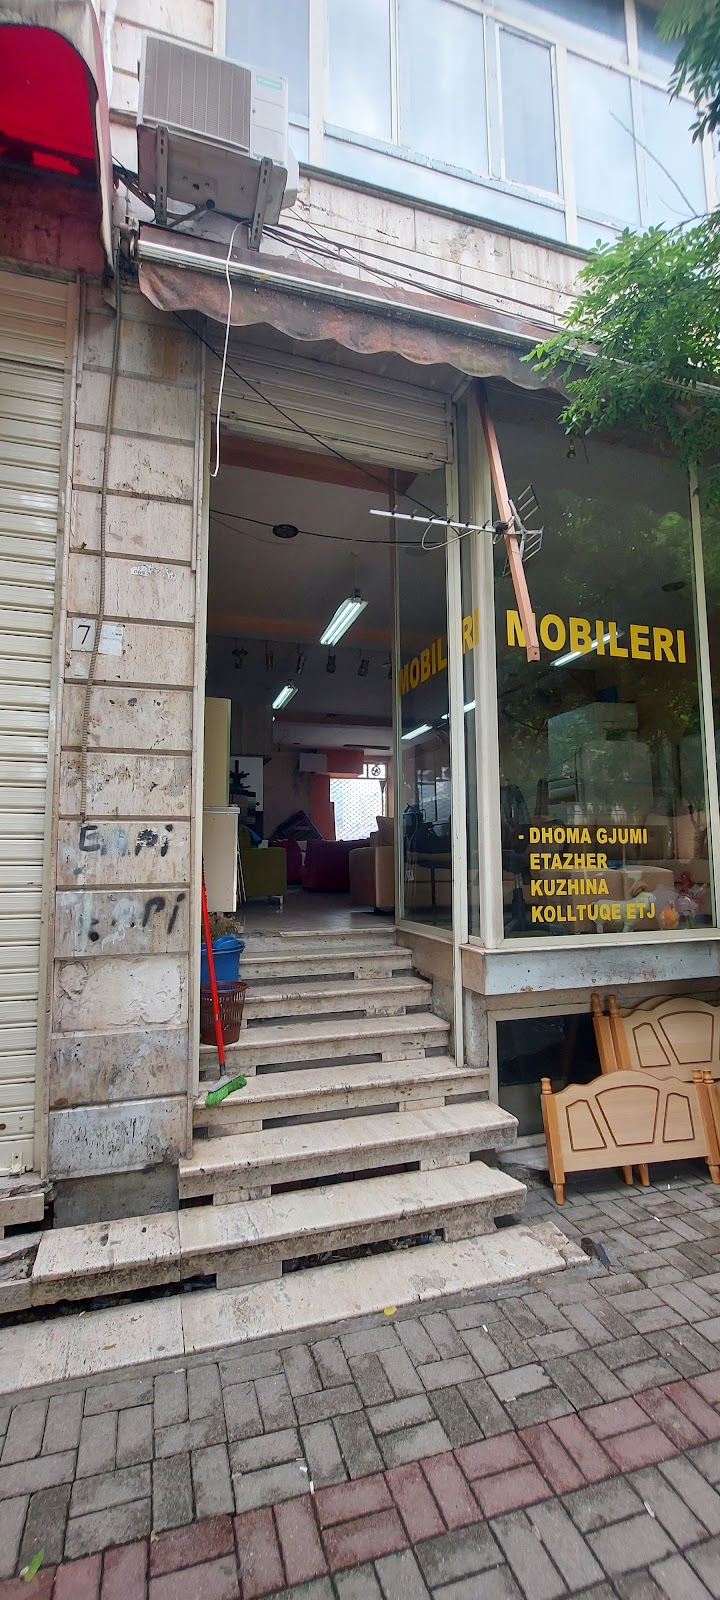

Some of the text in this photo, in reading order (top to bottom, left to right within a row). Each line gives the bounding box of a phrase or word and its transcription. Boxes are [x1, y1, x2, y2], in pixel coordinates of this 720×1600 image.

[77, 624, 91, 645] 7
[506, 609, 687, 664] MOBILERI
[398, 607, 479, 697] MOBILRI
[529, 827, 592, 844] DHOMA
[596, 827, 648, 844] GJUMI
[529, 853, 608, 870] ETAZHER
[530, 878, 609, 896] KUZHINA
[531, 902, 656, 923] KOLLTUQE ETJ
